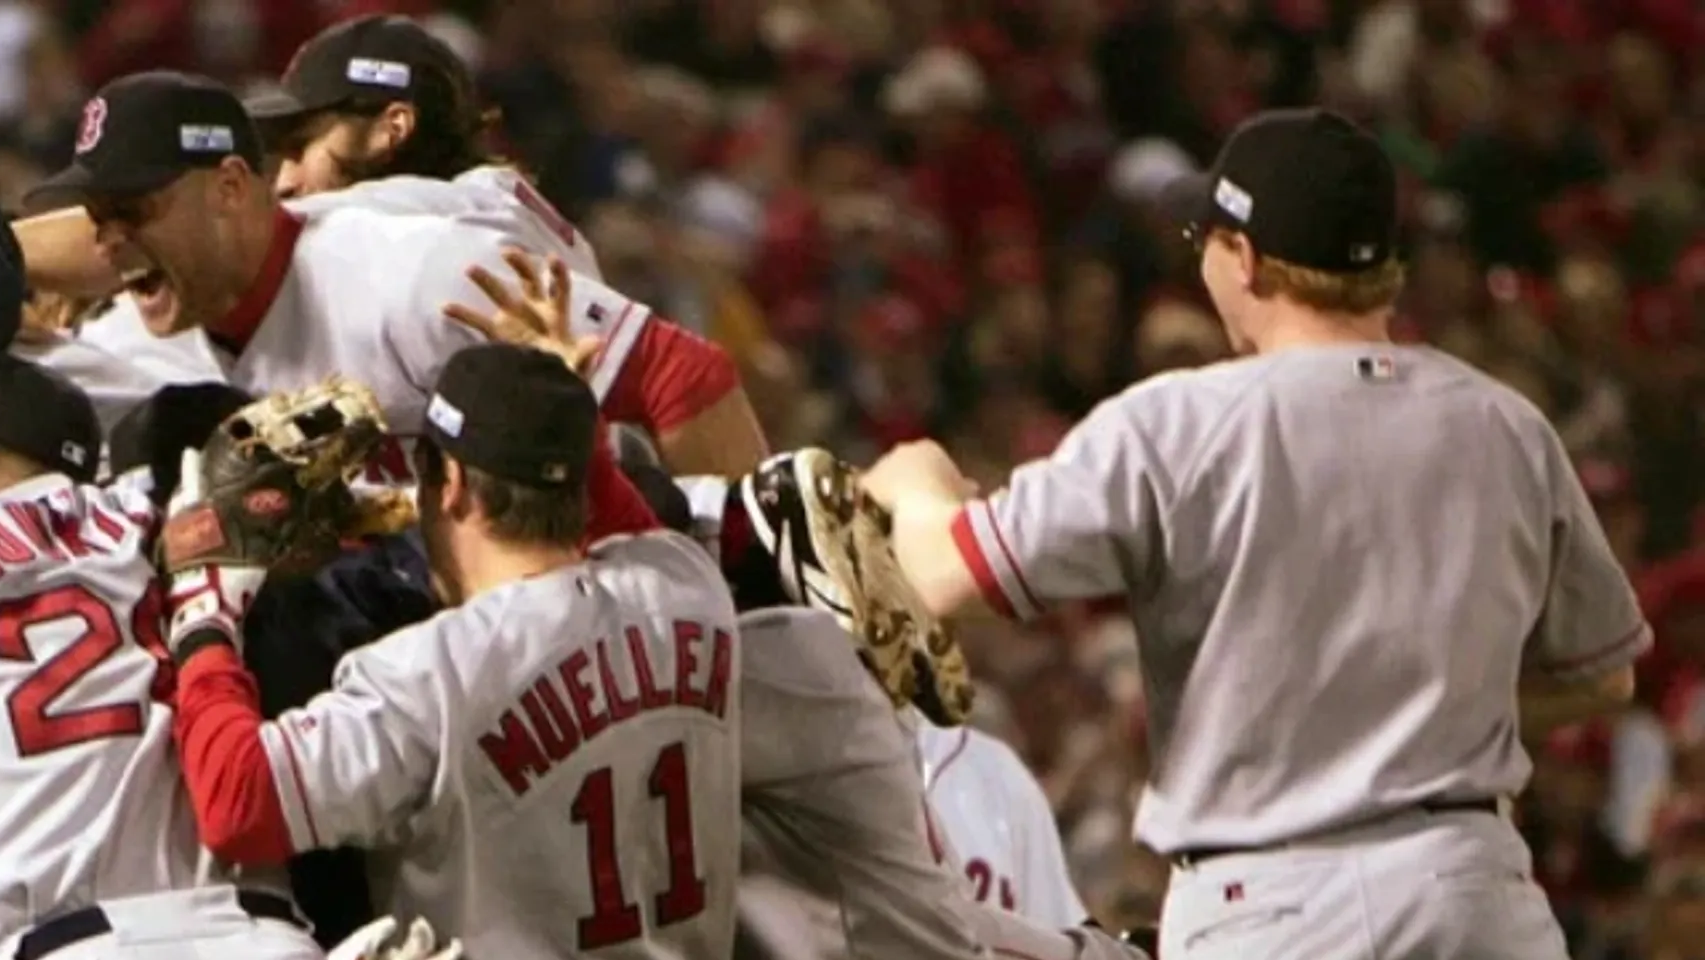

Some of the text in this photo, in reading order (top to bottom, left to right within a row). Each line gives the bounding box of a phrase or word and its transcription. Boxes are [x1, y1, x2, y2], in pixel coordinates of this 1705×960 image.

[75, 95, 108, 153] B
[477, 619, 732, 796] MUELLER
[570, 740, 706, 950] 11
